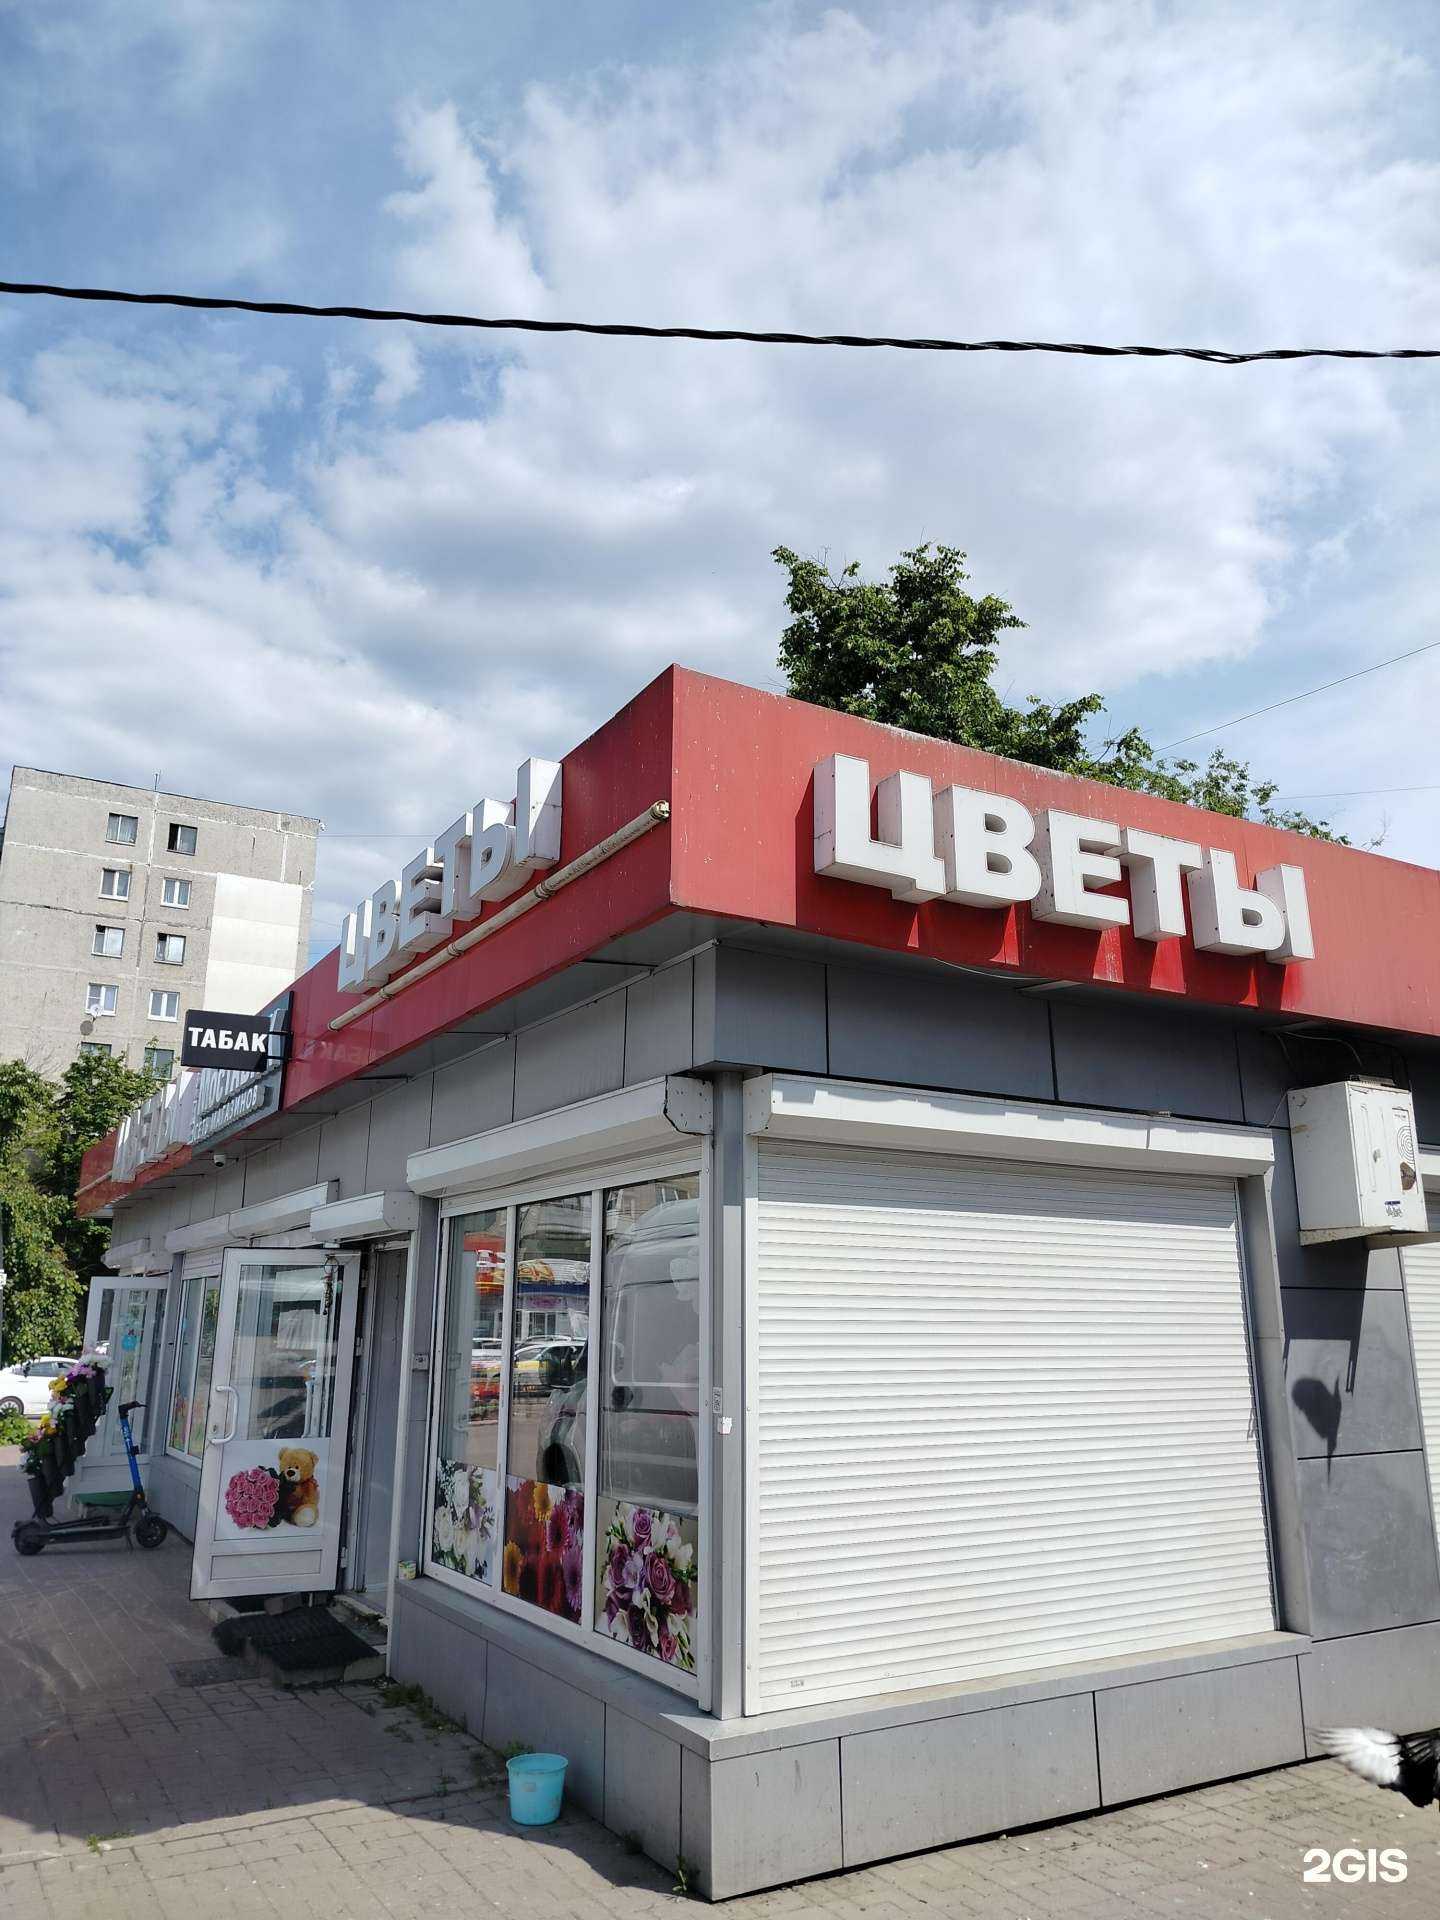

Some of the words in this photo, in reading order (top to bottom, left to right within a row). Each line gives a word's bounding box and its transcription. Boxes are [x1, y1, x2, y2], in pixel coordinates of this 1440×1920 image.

[337, 758, 562, 993] ЦВЕТЫ
[814, 753, 1316, 964] ЦВЕТЫ
[188, 1027, 267, 1053] ТАБАК
